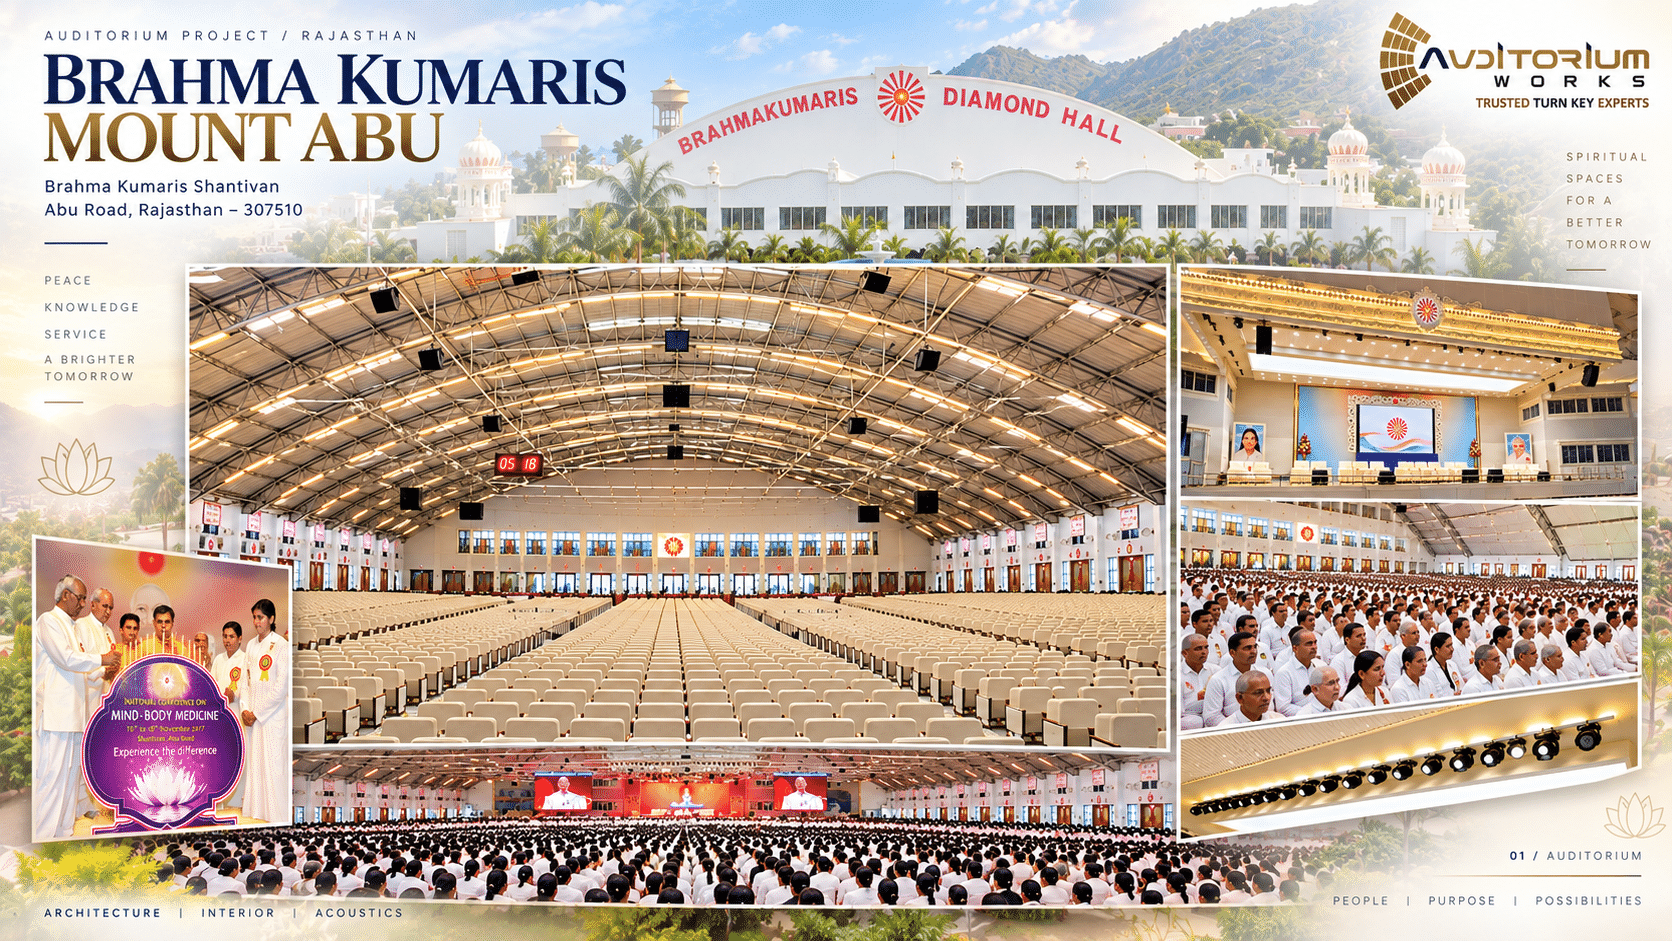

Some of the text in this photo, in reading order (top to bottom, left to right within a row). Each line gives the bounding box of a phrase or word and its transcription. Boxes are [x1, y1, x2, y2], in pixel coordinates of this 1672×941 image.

[678, 87, 1121, 155] BRAHMAKUMARIS DIAMOND HALL
[500, 457, 537, 470] 05 18
[175, 710, 219, 721] MEDICINE
[113, 746, 160, 758] Experience
[162, 745, 176, 756] the
